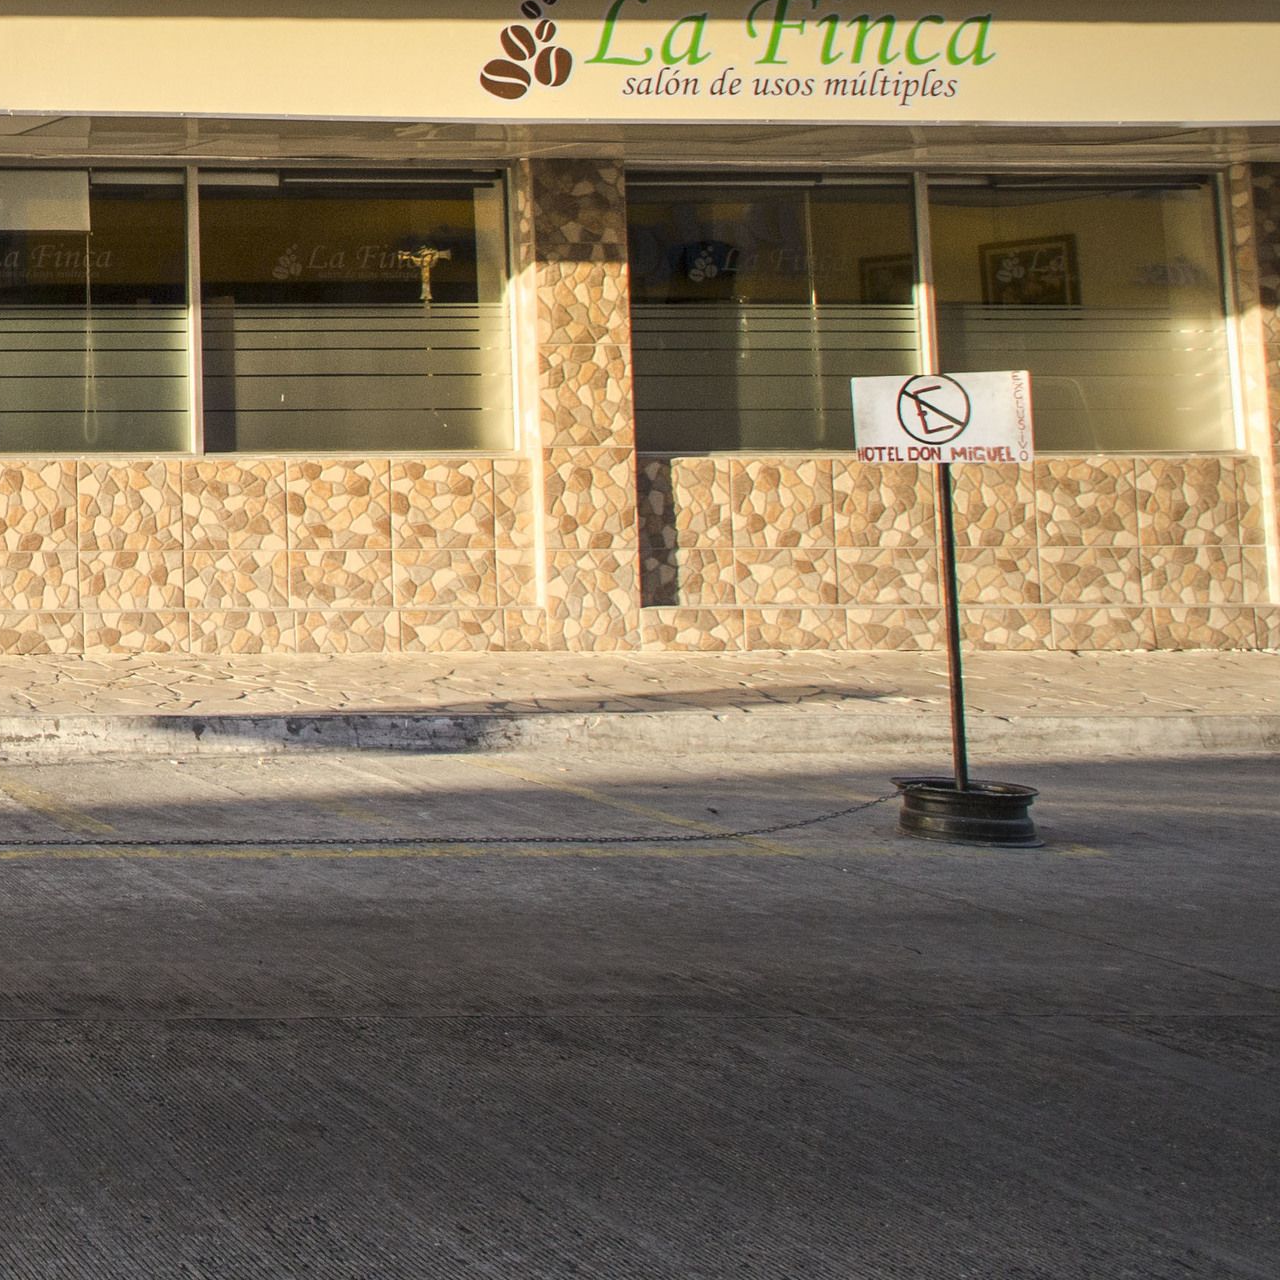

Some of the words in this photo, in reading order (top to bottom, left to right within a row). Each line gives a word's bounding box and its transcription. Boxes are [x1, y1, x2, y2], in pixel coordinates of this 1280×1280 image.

[622, 67, 698, 97] salón
[709, 67, 742, 97] de
[753, 77, 815, 97] usos
[824, 68, 958, 107] múltiples
[858, 447, 903, 462] HOTEL
[907, 446, 941, 461] DON
